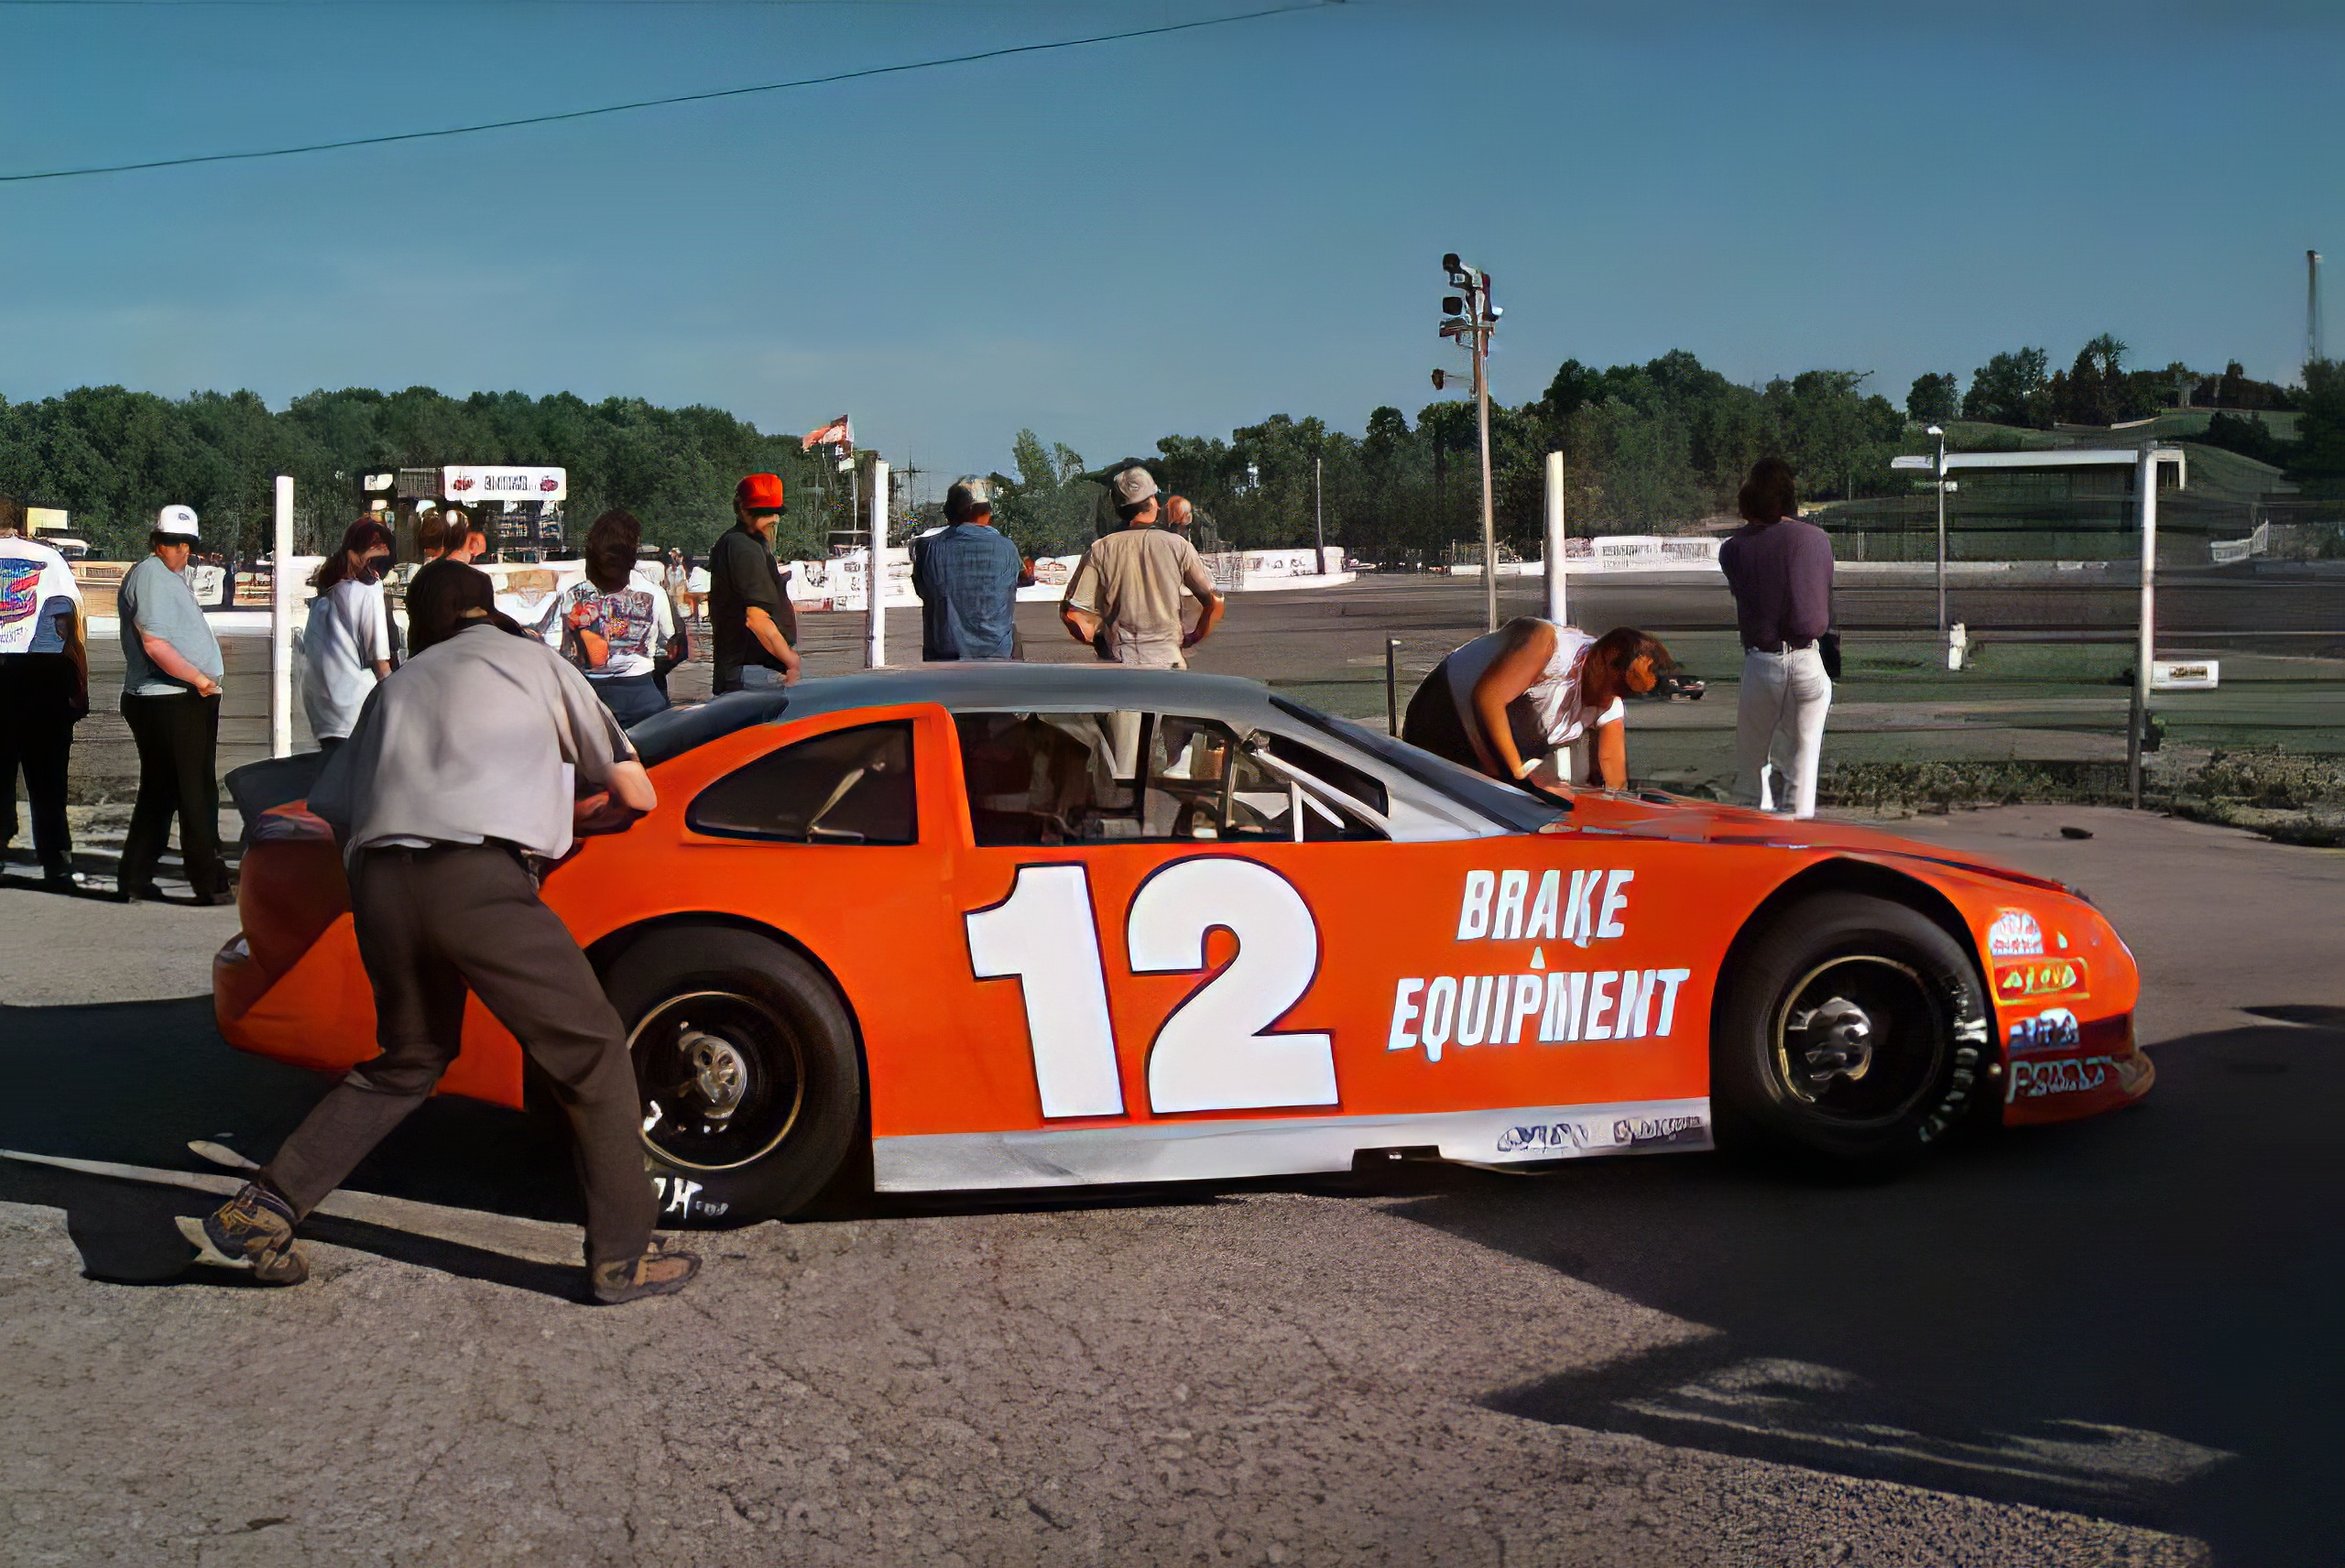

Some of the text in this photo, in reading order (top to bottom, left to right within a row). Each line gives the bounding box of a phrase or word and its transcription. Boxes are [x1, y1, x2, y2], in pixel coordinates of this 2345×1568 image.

[1456, 869, 1635, 948] BRAKE
[965, 855, 1341, 1117] 12
[1387, 968, 1691, 1062] EQUIPMENT
